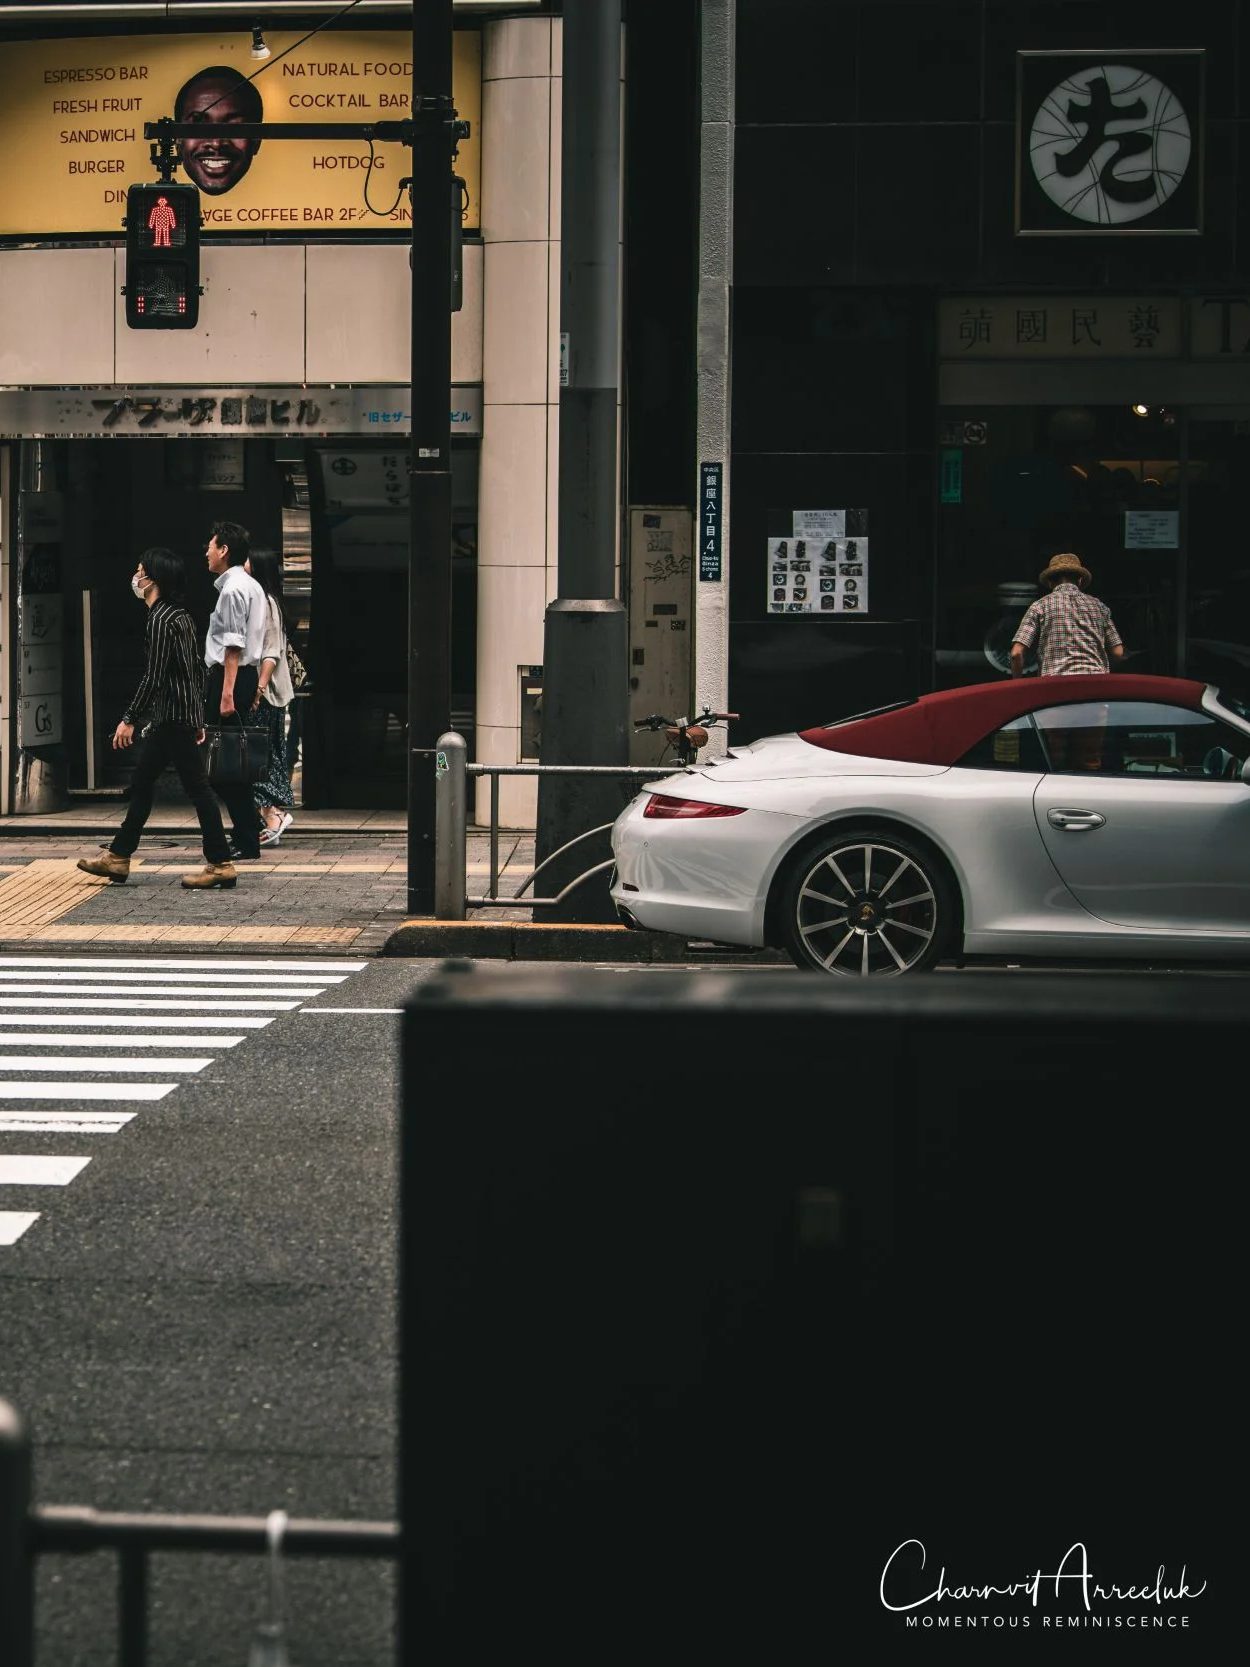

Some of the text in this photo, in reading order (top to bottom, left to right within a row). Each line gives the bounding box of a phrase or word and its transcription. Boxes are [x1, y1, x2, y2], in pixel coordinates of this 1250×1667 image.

[44, 66, 148, 84] ESPRESSO BAR
[283, 63, 360, 76] NATURAL
[53, 98, 142, 114] FRESH FRUIT
[289, 94, 409, 107] COCKTAIL BAR
[60, 129, 135, 144] SANDWICH
[68, 160, 125, 174] BURGER
[313, 156, 385, 169] HOTDOG
[237, 208, 299, 222] COFFEE
[303, 207, 334, 221] BAR
[339, 207, 358, 221] 2F
[1203, 299, 1250, 354] T
